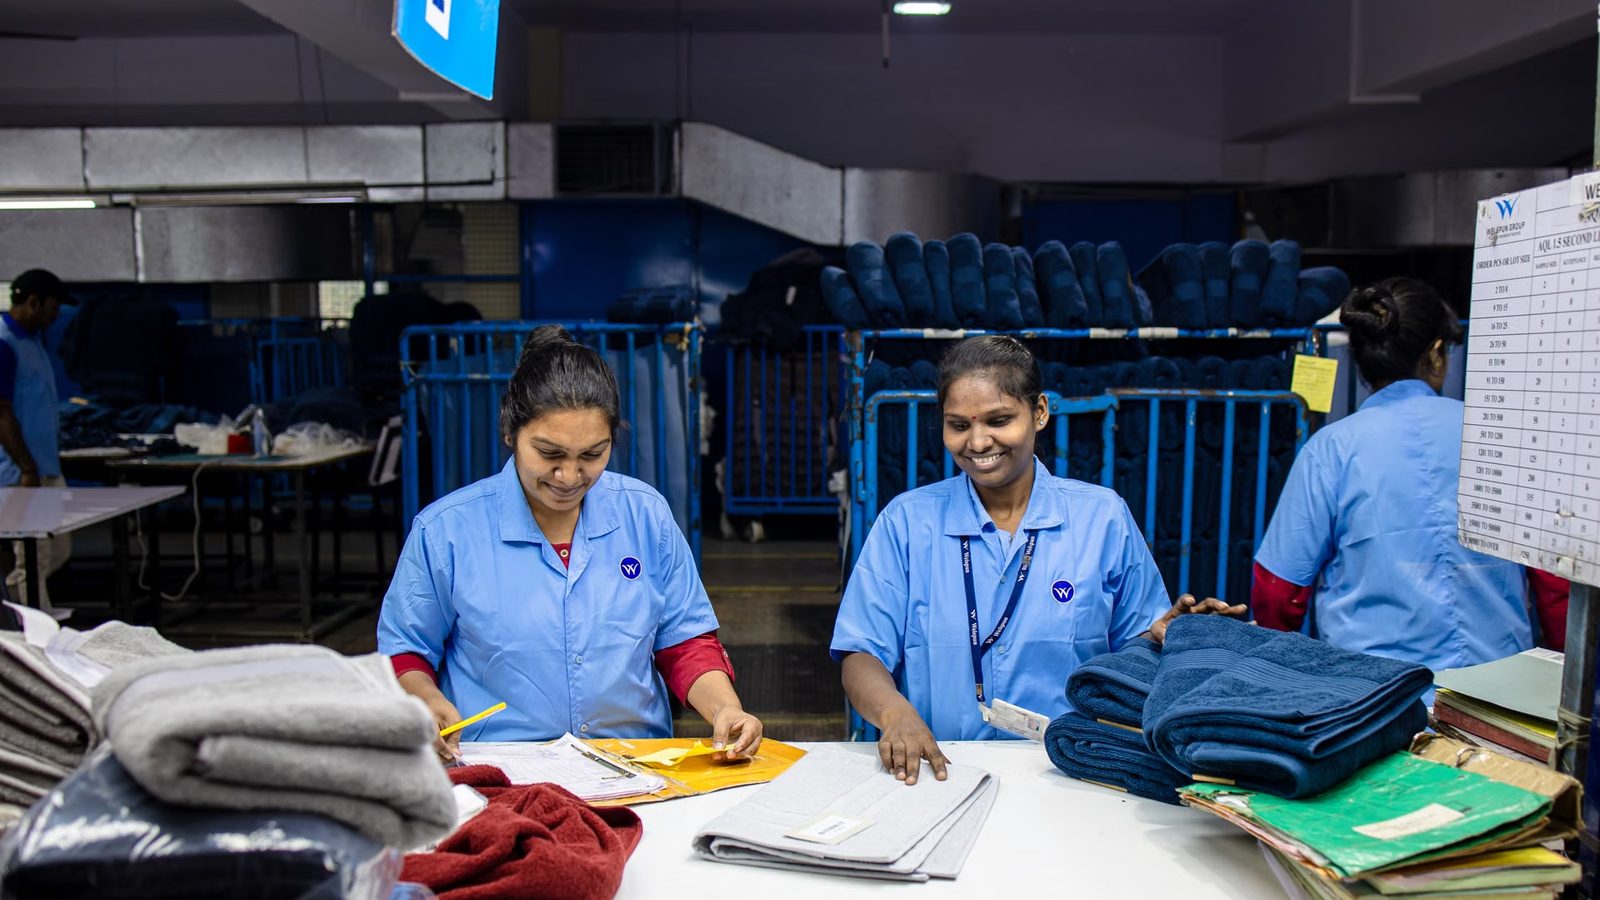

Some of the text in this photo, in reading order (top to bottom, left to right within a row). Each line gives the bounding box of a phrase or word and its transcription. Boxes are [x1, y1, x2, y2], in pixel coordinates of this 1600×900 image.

[1509, 221, 1525, 231] GROUP
[1538, 240, 1551, 252] AQL
[1562, 232, 1592, 248] SECOND
[1476, 254, 1530, 270] ORDER PCS OR LOT SIZE
[1487, 541, 1499, 551] OVER
[993, 616, 1008, 637] Welspun
